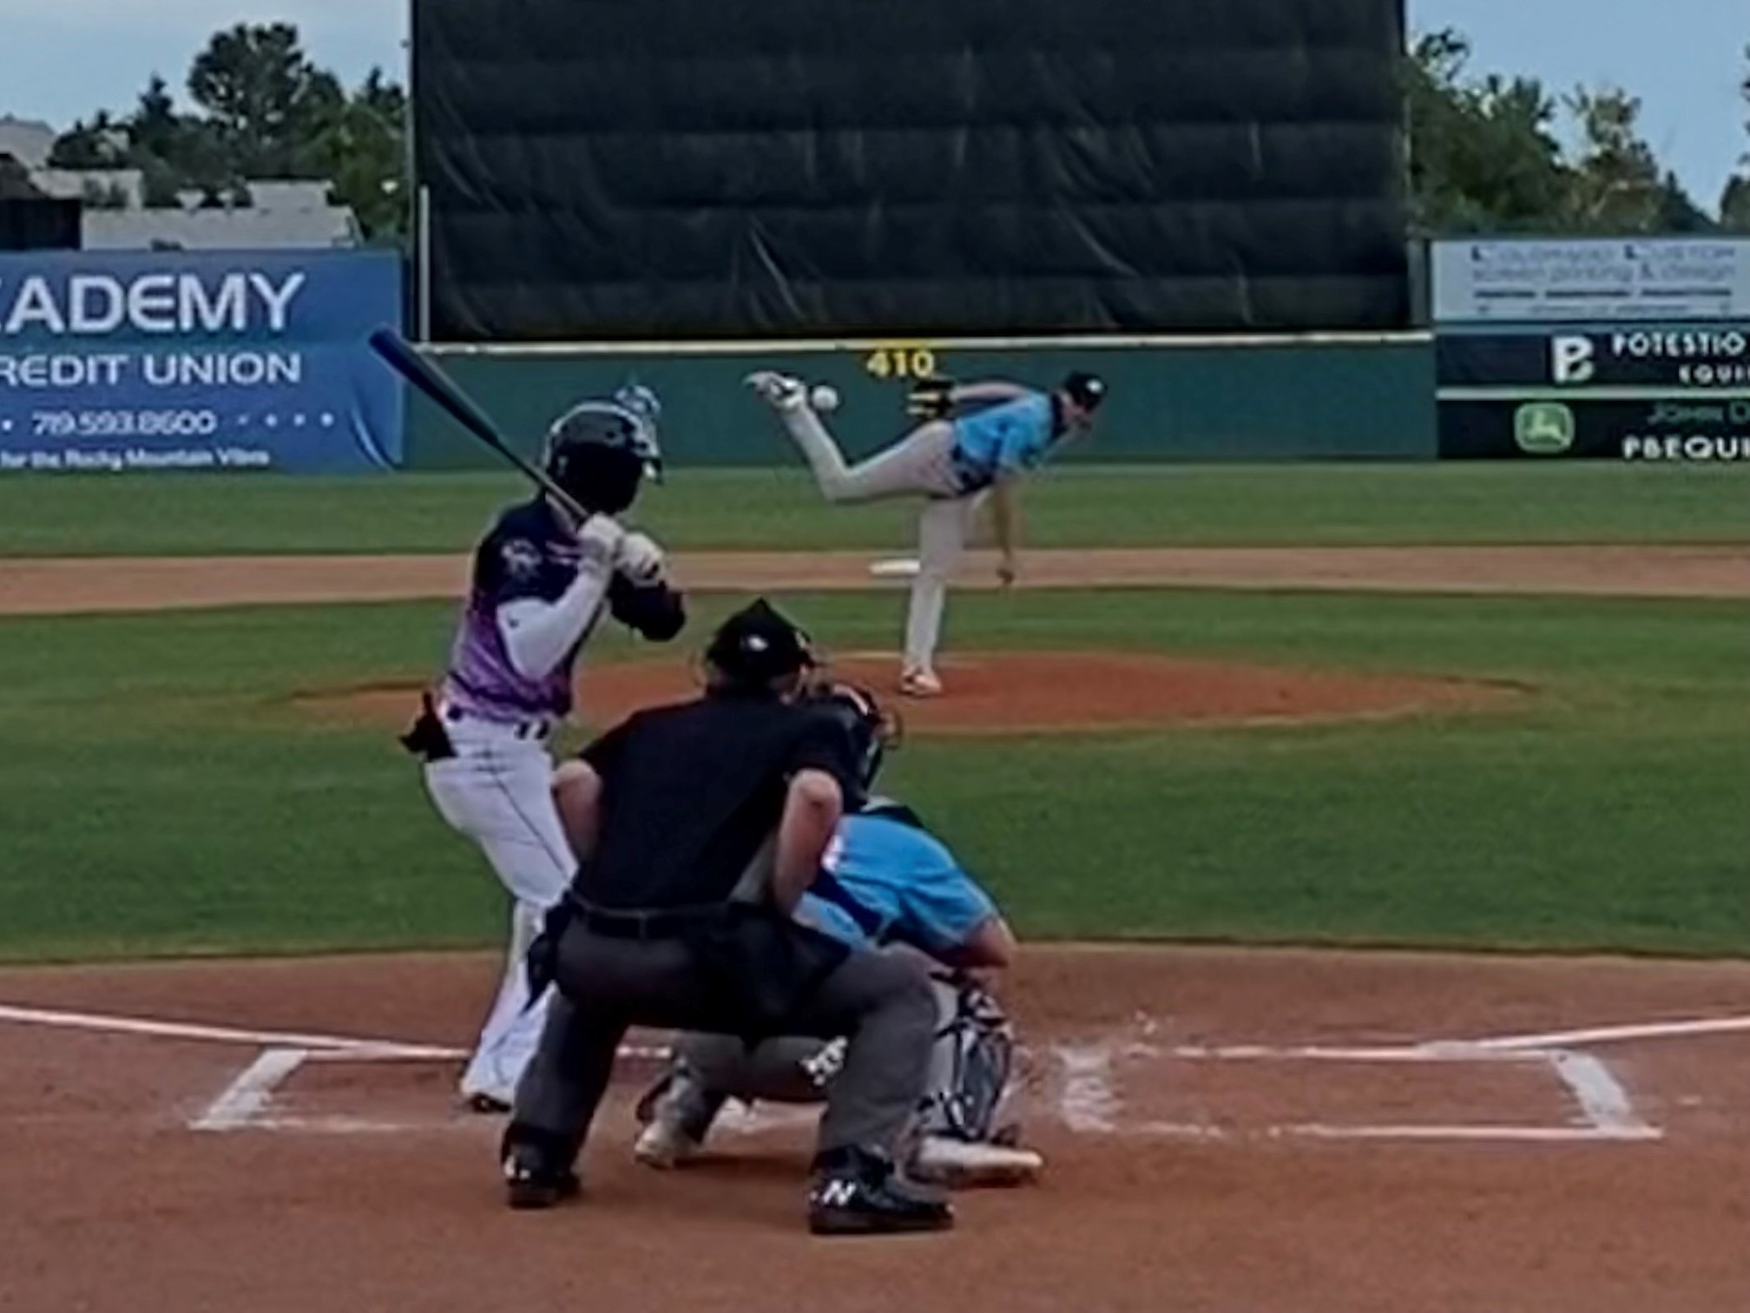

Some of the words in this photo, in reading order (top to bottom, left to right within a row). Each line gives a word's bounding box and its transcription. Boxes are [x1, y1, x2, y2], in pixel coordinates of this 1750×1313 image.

[1612, 331, 1747, 358] POTESTIO
[143, 352, 303, 385] UNION
[865, 350, 936, 378] 410
[1678, 363, 1750, 385] EQUI
